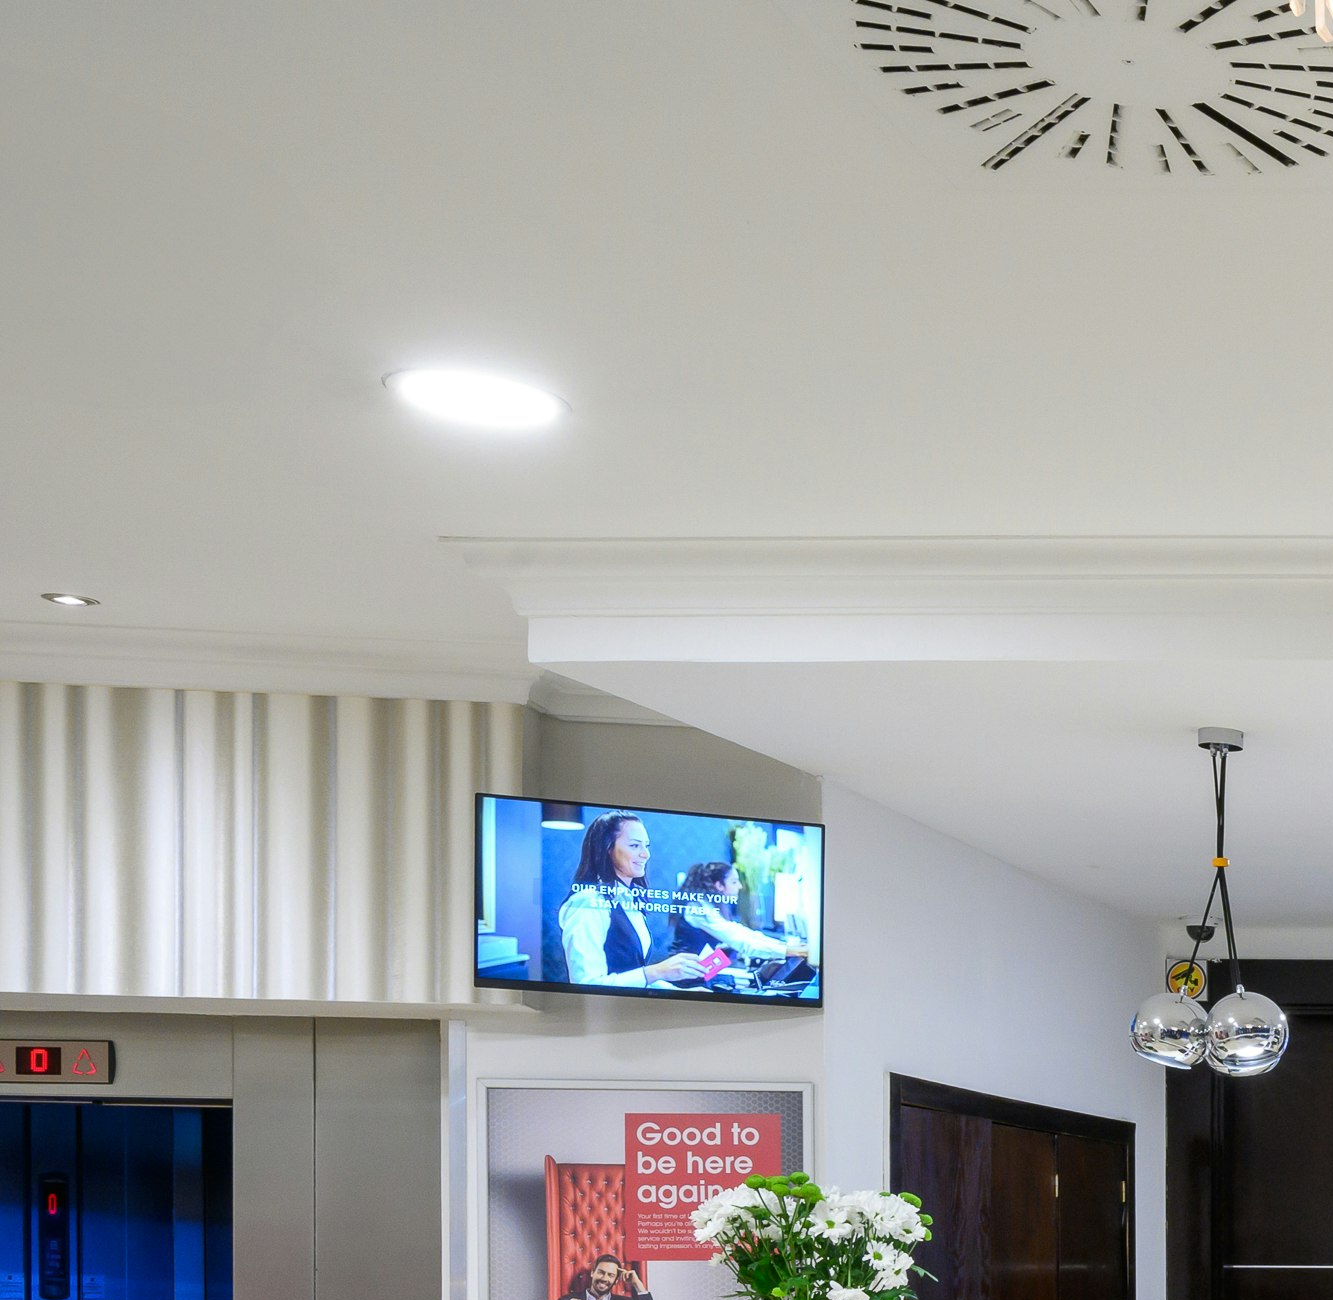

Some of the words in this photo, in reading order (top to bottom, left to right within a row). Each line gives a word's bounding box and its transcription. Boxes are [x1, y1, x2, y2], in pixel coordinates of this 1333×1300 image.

[571, 883, 597, 894] OUR
[599, 885, 669, 900] EMPLOYEES
[672, 891, 704, 902] MAKE
[706, 893, 738, 905] YOUR
[590, 900, 619, 910] STAY
[622, 902, 721, 917] UNFORGETTABLE
[30, 1048, 48, 1072] 0
[636, 1122, 722, 1146] Good
[731, 1122, 760, 1146] to
[637, 1151, 677, 1174] be
[687, 1151, 753, 1174] here
